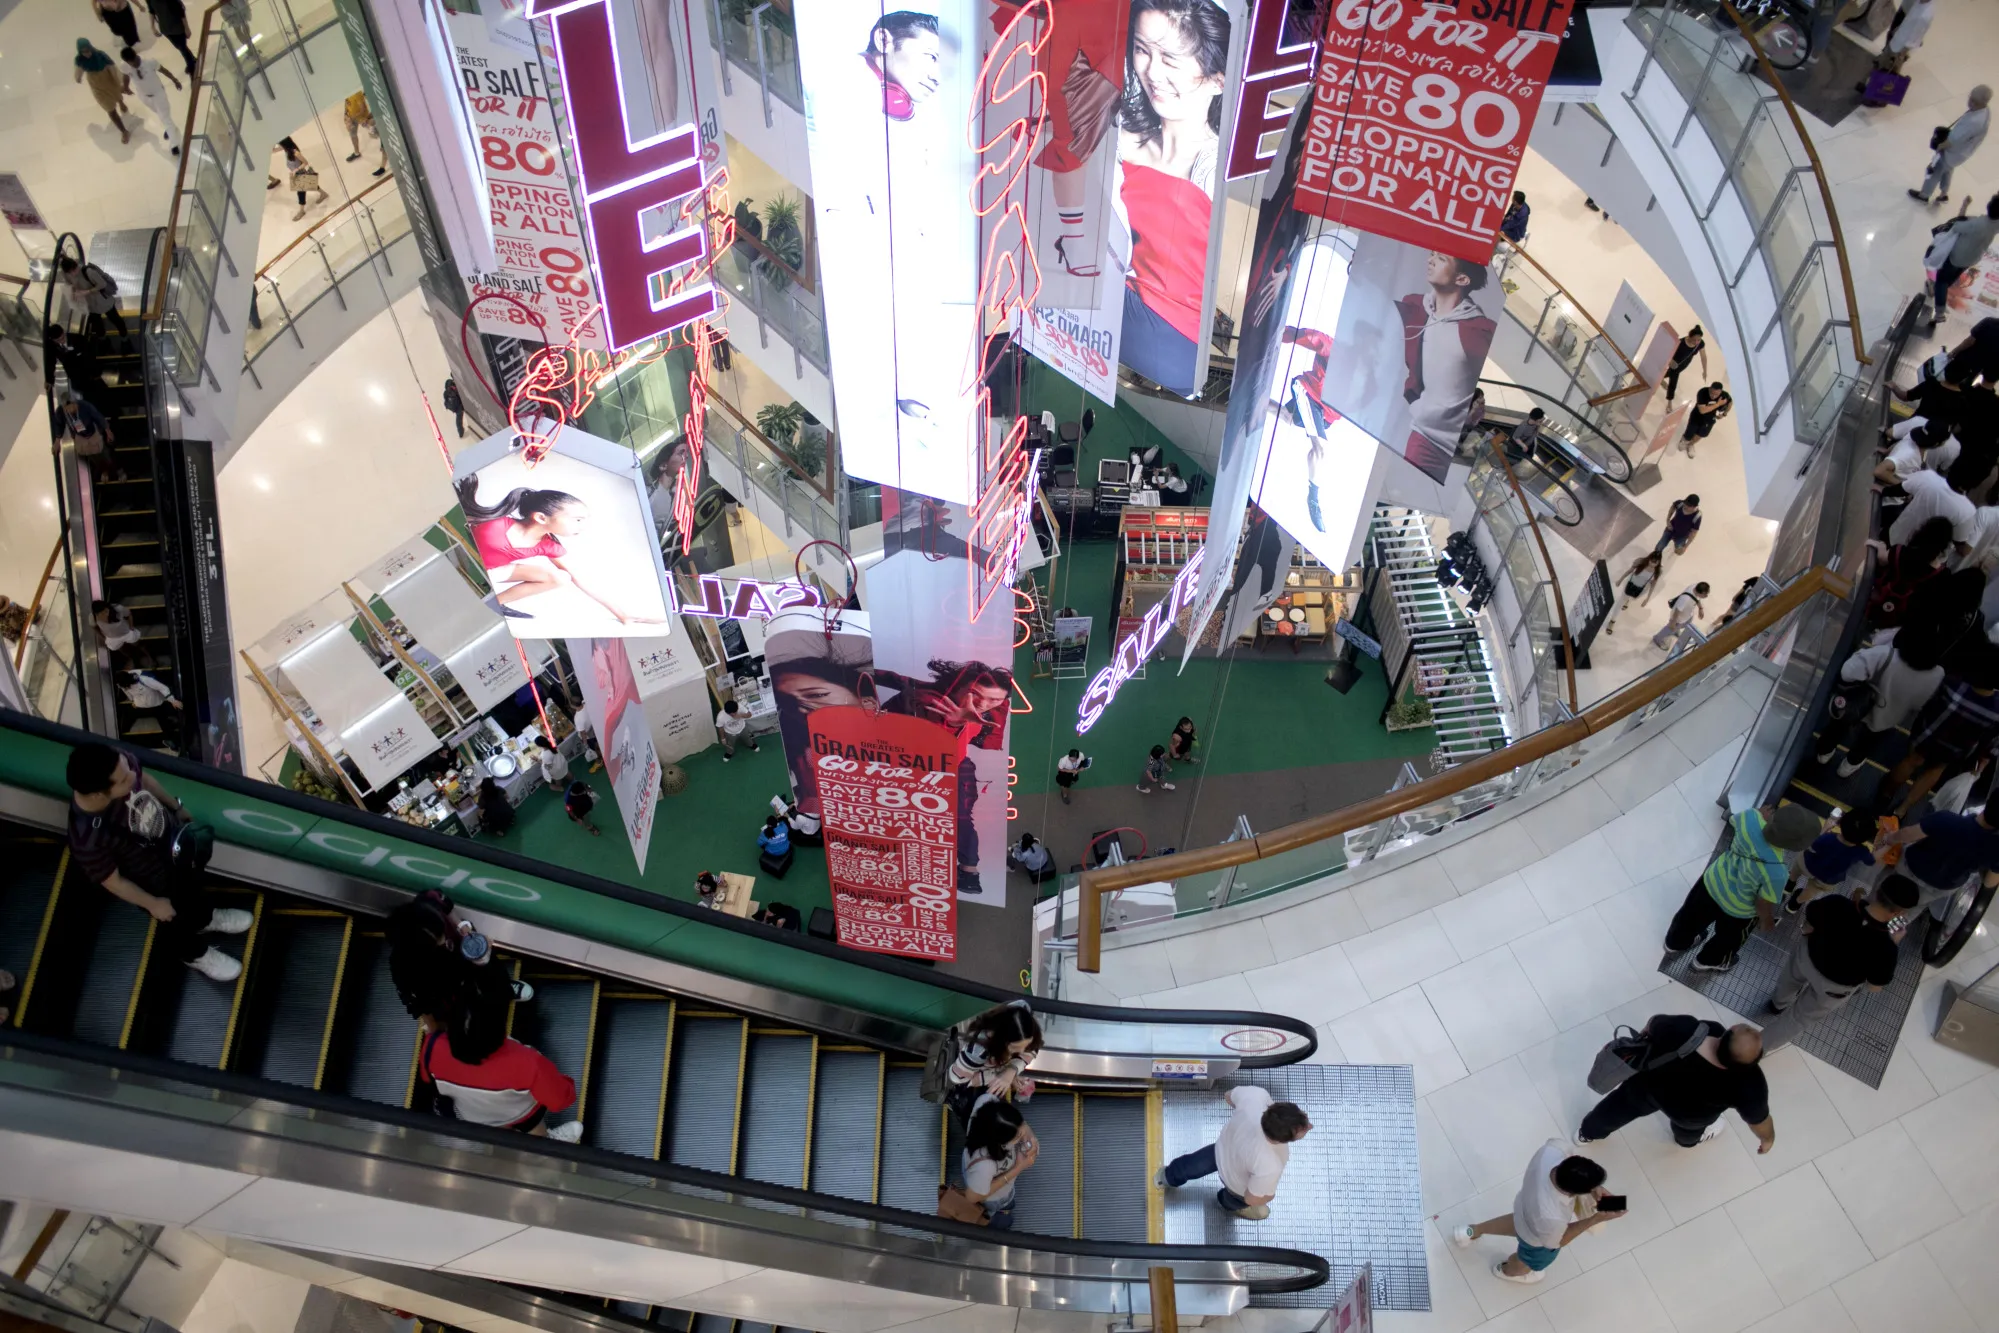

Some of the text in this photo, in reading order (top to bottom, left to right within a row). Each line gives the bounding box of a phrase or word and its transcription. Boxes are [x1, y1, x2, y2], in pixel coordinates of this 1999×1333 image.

[1335, 0, 1560, 71] GO FOR IT
[1320, 62, 1404, 99] SAVE
[516, 95, 548, 122] IT
[1317, 84, 1398, 117] UP TO
[1310, 114, 1513, 189] SHOPPING
[1306, 137, 1507, 210] DESTINATION
[490, 183, 571, 207] PPING
[491, 198, 575, 220] INATION
[1303, 157, 1496, 237] FOR ALL
[520, 214, 578, 238] ALL
[496, 238, 535, 252] PING
[505, 256, 540, 269] ALL
[478, 306, 506, 316] SAVE
[812, 732, 956, 773] GRAND SALE
[818, 754, 956, 786] GO FOR IT
[818, 780, 872, 796] SAVE
[820, 789, 872, 805] UP TO
[823, 799, 955, 829] SHOPPING
[823, 808, 955, 836] DESTINATION
[825, 816, 955, 847] FOR ALL
[907, 842, 921, 881] SHOPPING
[921, 844, 932, 884] DESTINATION
[932, 848, 949, 886] FOR ALL
[838, 917, 954, 942] SHOPPING
[920, 908, 934, 929] SAVE
[839, 926, 954, 949] DESTINATION
[840, 931, 954, 958] FOR ALL
